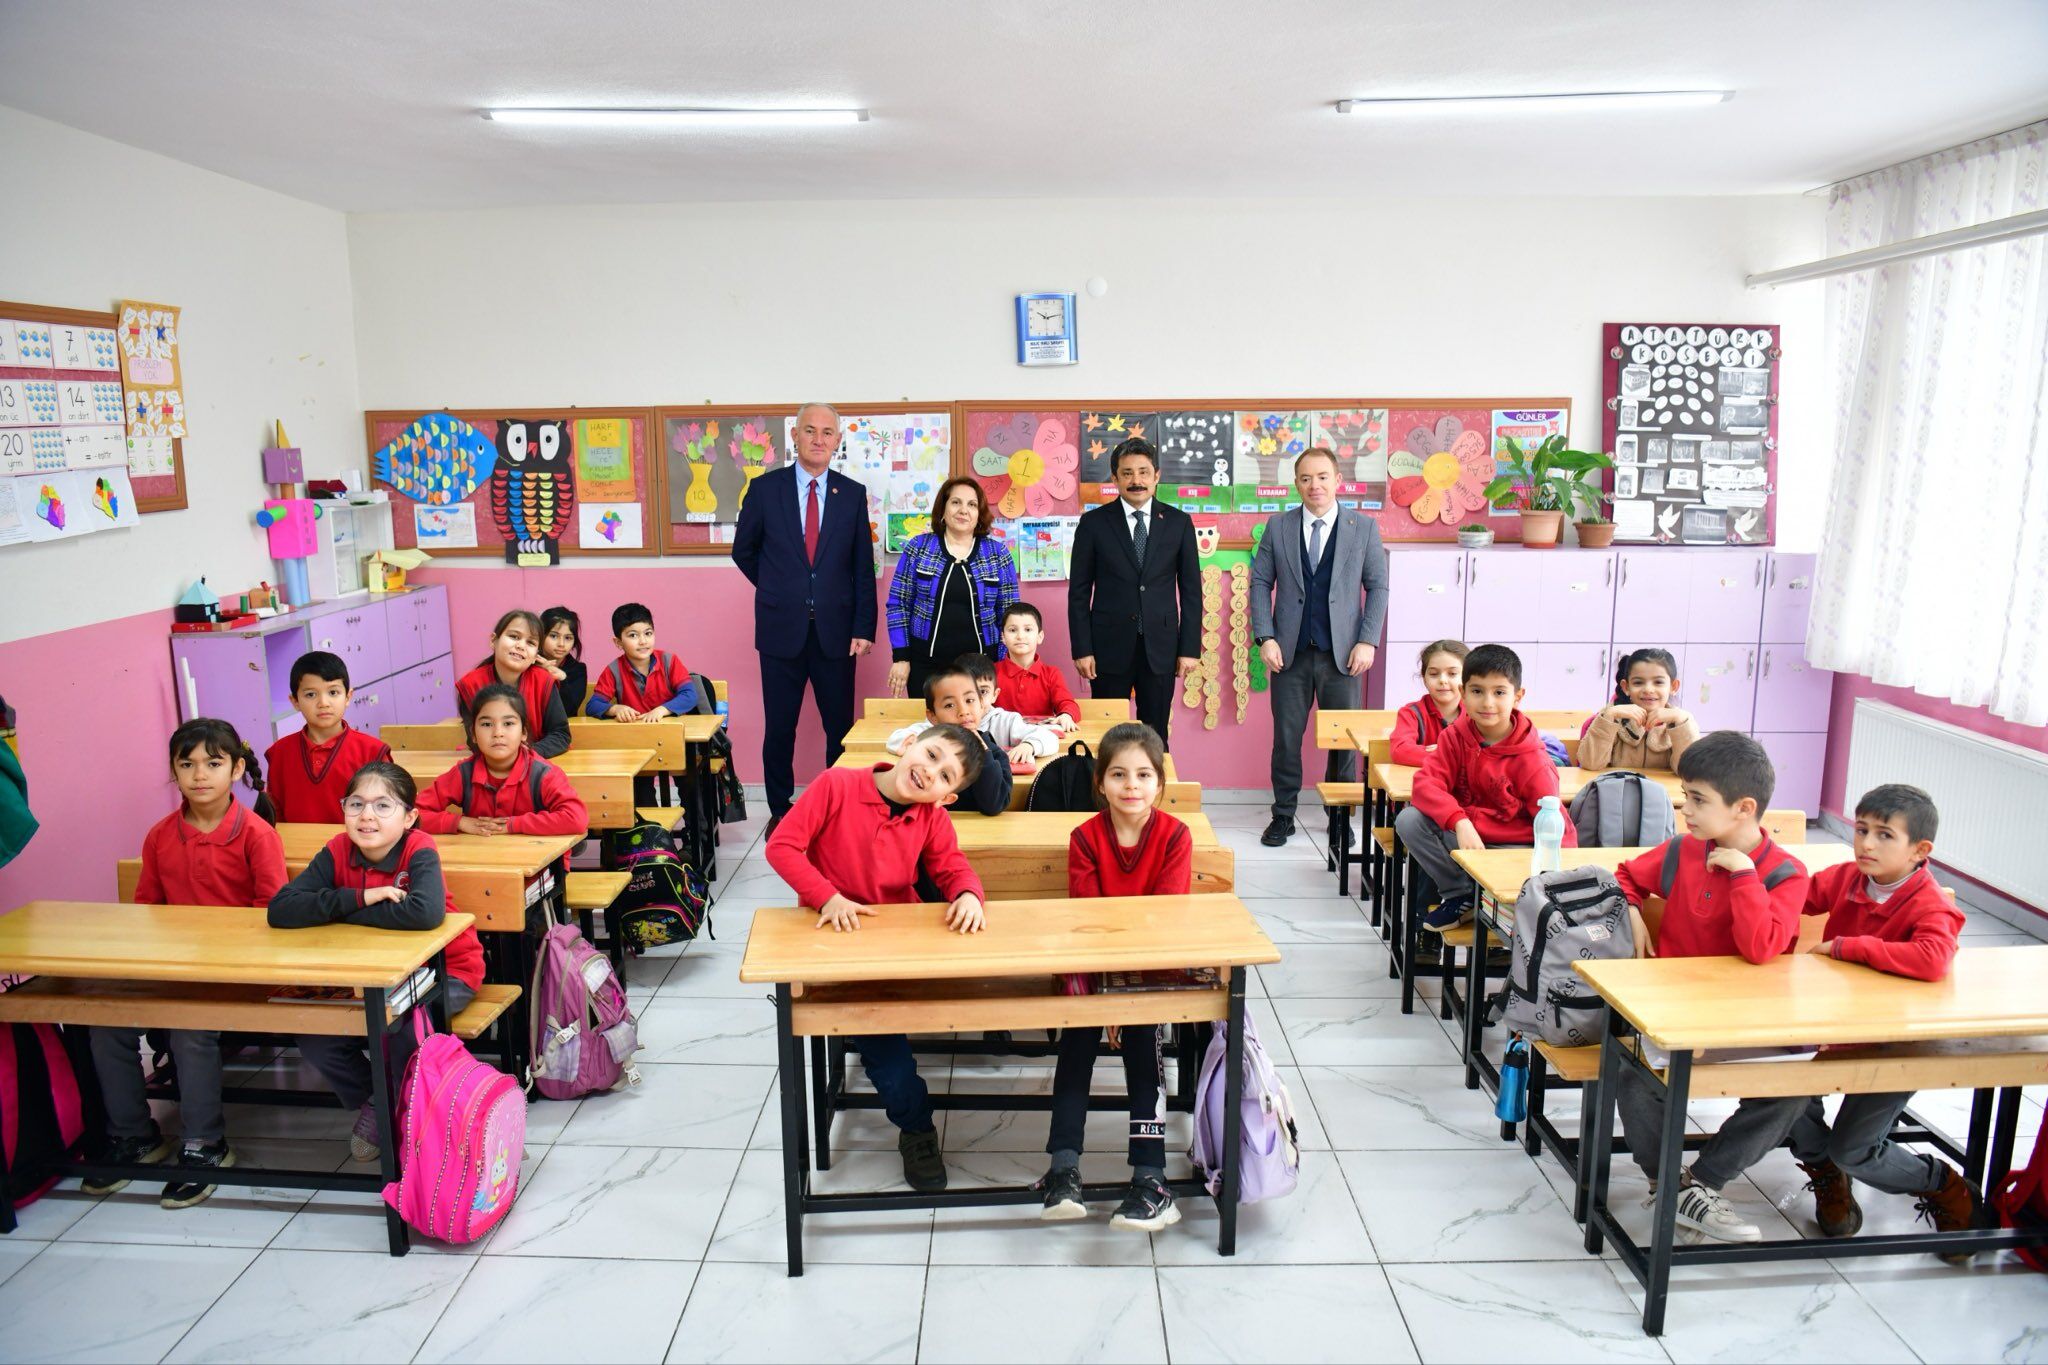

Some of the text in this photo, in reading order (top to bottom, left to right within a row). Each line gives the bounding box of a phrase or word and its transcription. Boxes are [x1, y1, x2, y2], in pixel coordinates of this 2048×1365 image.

[65, 330, 73, 351] 7
[1628, 329, 1763, 345] ATATÜRK
[67, 387, 86, 407] 14
[1515, 412, 1547, 420] GÜNLER
[1, 434, 23, 456] 20
[980, 456, 1003, 467] SAAT
[693, 490, 705, 501] 10
[1235, 565, 1246, 578] 2
[1235, 580, 1247, 591] 4
[1235, 596, 1243, 609] 6
[1235, 613, 1243, 627] 8
[1234, 630, 1246, 642] 10
[1236, 646, 1246, 659] 12
[1235, 660, 1246, 673] 14
[1235, 676, 1247, 689] 16
[1606, 895, 1626, 933] GUESS
